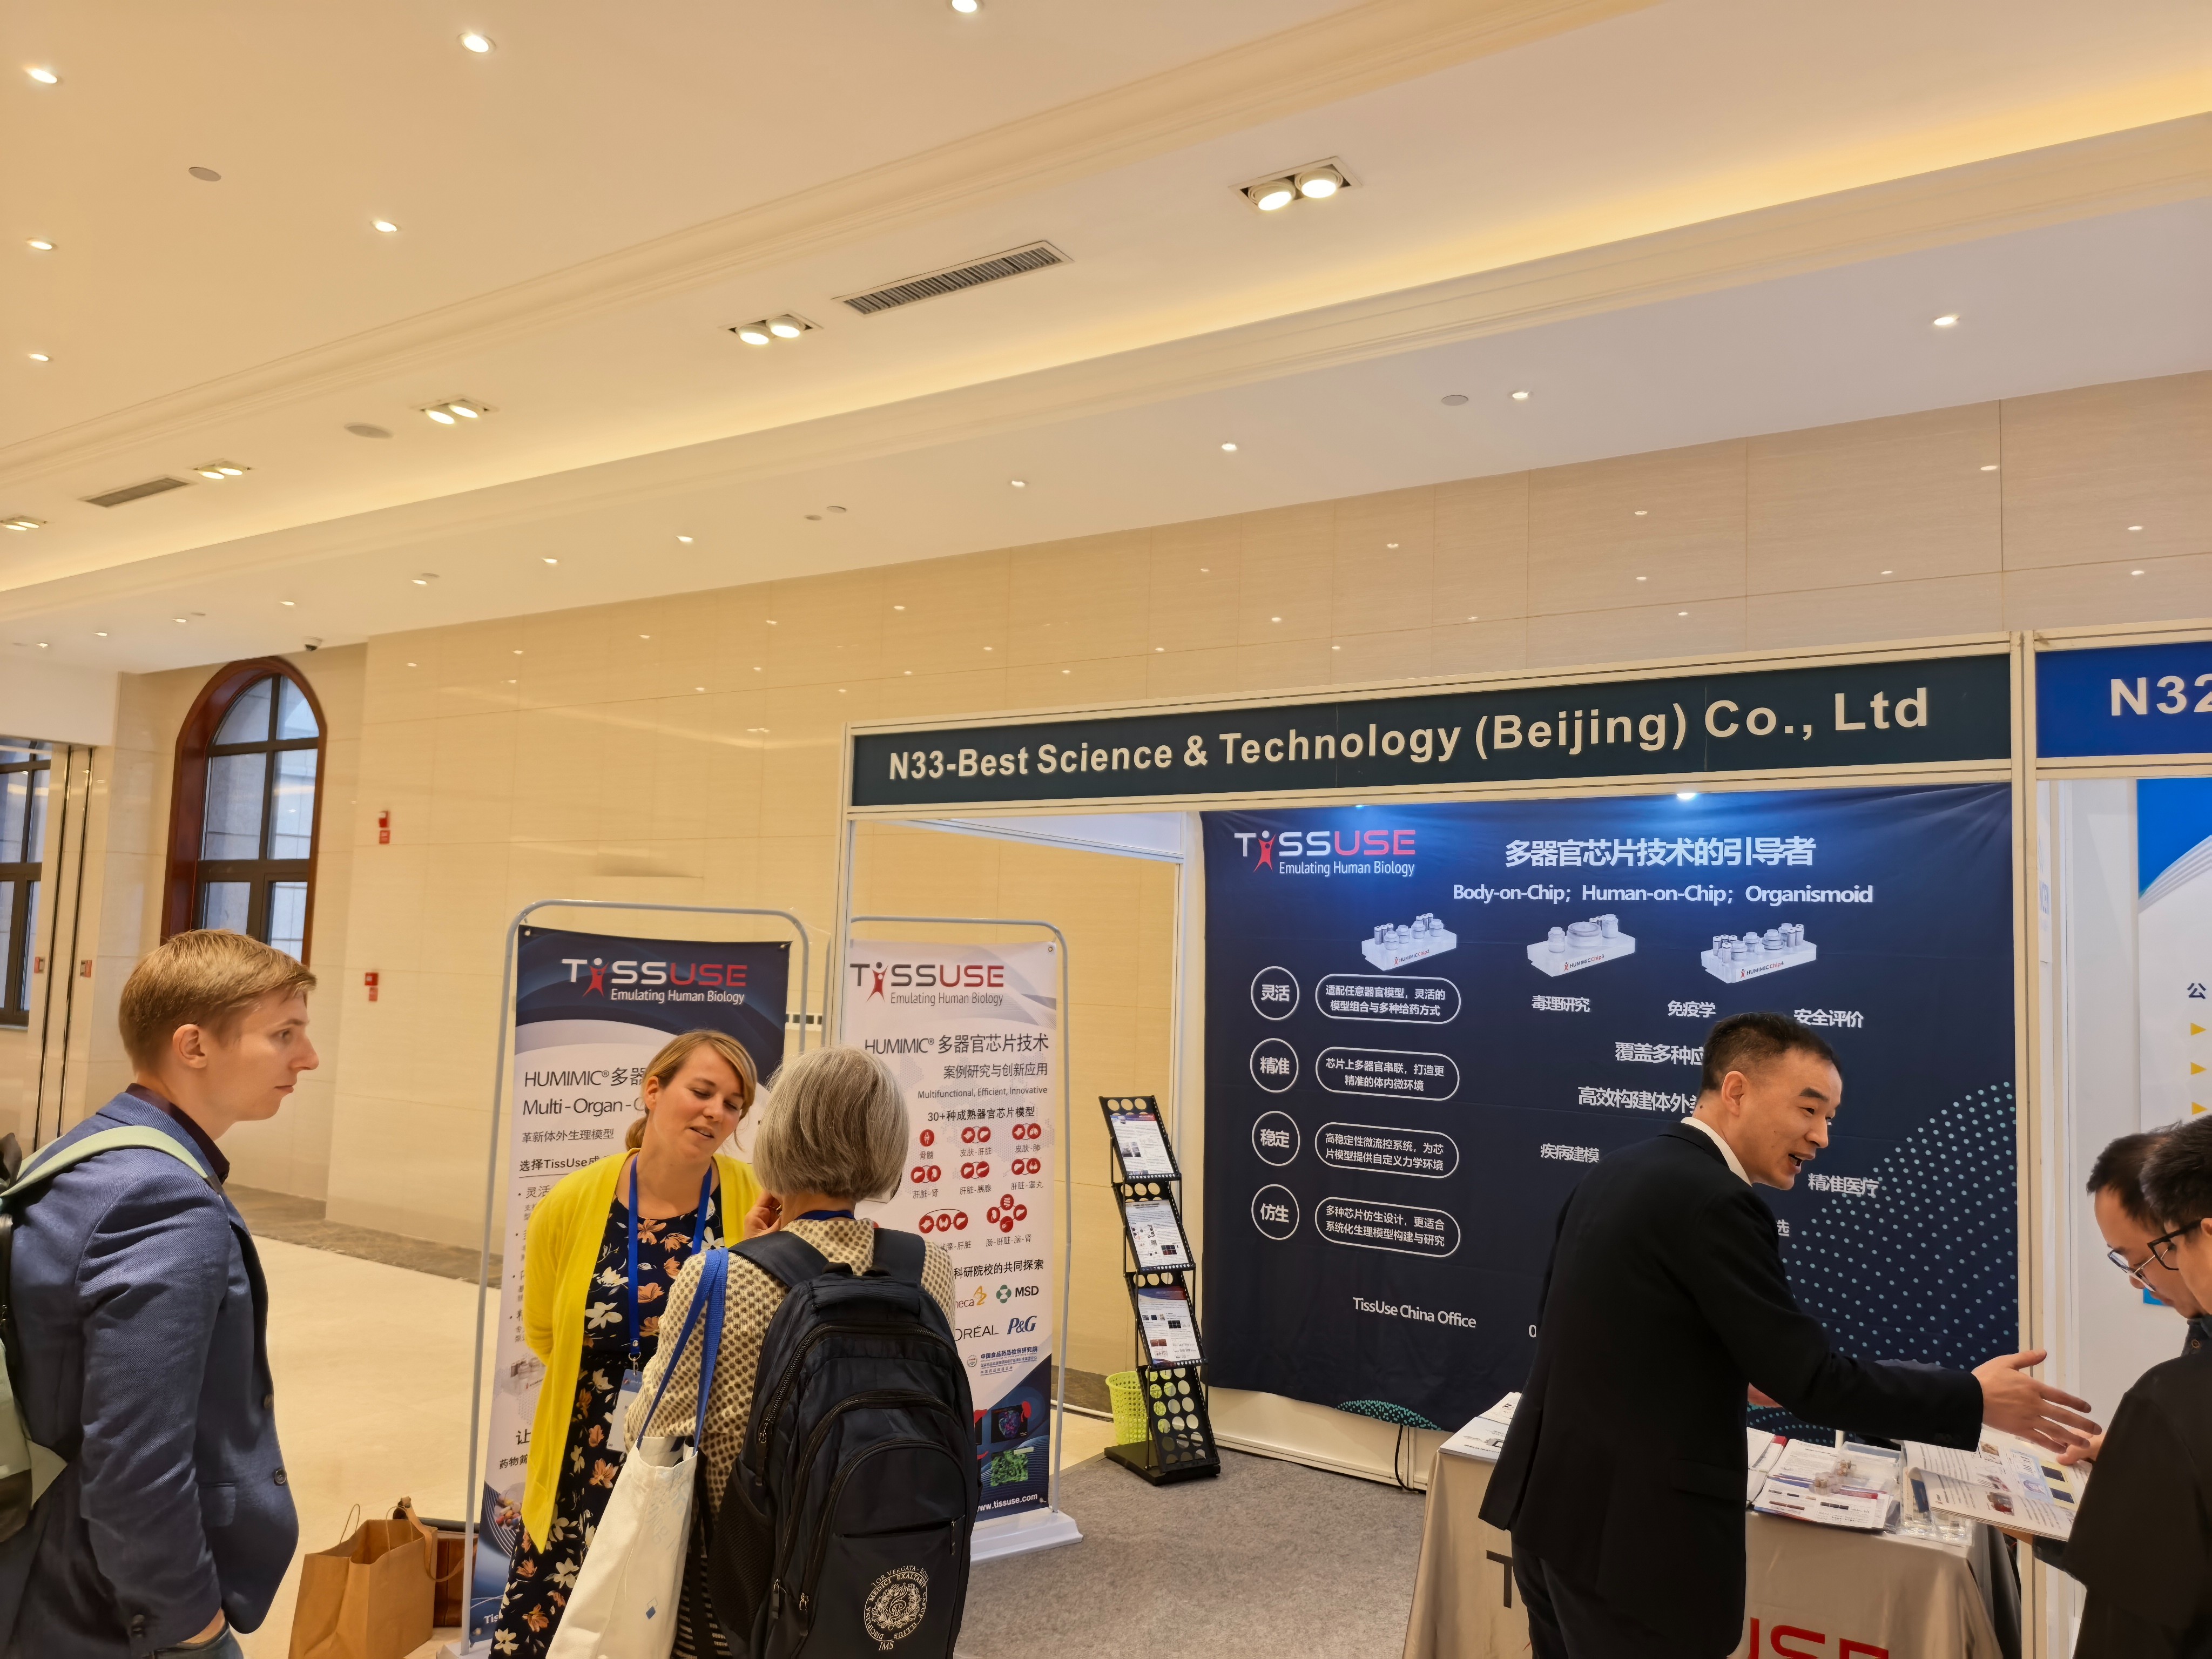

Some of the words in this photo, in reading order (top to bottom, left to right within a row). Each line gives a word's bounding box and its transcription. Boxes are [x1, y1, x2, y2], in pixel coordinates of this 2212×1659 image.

[2110, 673, 2212, 716] N32
[889, 746, 1028, 780] N33-Best
[1037, 741, 1172, 774] Science
[1183, 736, 1208, 766] &
[1219, 724, 1461, 763] Technology
[1475, 703, 1687, 760] (Beijing)
[1704, 700, 1813, 742] Co.,
[1835, 687, 1928, 732] Ltd
[1505, 836, 1817, 867] 多器官芯片技术的引导者
[1279, 862, 1330, 877] Emulating
[1333, 861, 1370, 874] Human
[1374, 860, 1414, 877] Biology
[1745, 885, 1872, 907] Organismoid
[1569, 958, 1590, 968] HUMIMIC
[1746, 965, 1769, 975] HUMIMIC
[611, 989, 665, 1003] Emulating
[668, 990, 704, 1002] Human
[707, 991, 744, 1004] Biology
[891, 993, 935, 1006] Emulating
[939, 993, 969, 1004] Human
[972, 993, 1003, 1006] Biology
[1261, 984, 1290, 1002] 灵活
[1326, 985, 1446, 1001] 适配任意器官模型，灵活的
[2187, 982, 2207, 1000] 公
[1330, 1000, 1440, 1016] 模型组合与多种给药方式
[1532, 995, 1590, 1013] 毒理研究
[1667, 1001, 1716, 1019] 免疫学
[1794, 1009, 1864, 1028] 安全评价
[938, 1034, 1049, 1054] 多器官芯片技术
[943, 1063, 1048, 1080] 案例研究与创新应用
[1260, 1057, 1290, 1075] 精准
[1326, 1058, 1445, 1077] 芯片上多器官串联，打造更
[1345, 1075, 1424, 1091] 精准的体内微环境
[918, 1089, 975, 1099] Multifunctional,
[977, 1088, 1008, 1097] Efficient,
[1010, 1087, 1048, 1095] Innovative
[927, 1106, 1035, 1122] 30+种成熟器官芯片模型
[522, 1128, 614, 1143] 革新体外生理模型
[1260, 1130, 1290, 1148] 稳定
[1325, 1133, 1444, 1155] 高稳定性微流控系统，为芯
[1325, 1148, 1444, 1171] 片模型提供自定义力学环境
[1540, 1143, 1600, 1163] 疾病建模
[1808, 1173, 1879, 1196] 精准医疗
[1260, 1204, 1289, 1223] 仿生
[1326, 1205, 1445, 1231] 多种芯片仿生设计，更适合
[1326, 1220, 1445, 1247] 系统化生理模型构建与研究
[953, 1258, 1044, 1279] 科研院校的共同探索
[1015, 1285, 1039, 1298] MSD
[1353, 1297, 1398, 1316] TissUse
[1400, 1305, 1434, 1323] China
[1438, 1311, 1476, 1328] Office
[1007, 1316, 1037, 1334] P&G
